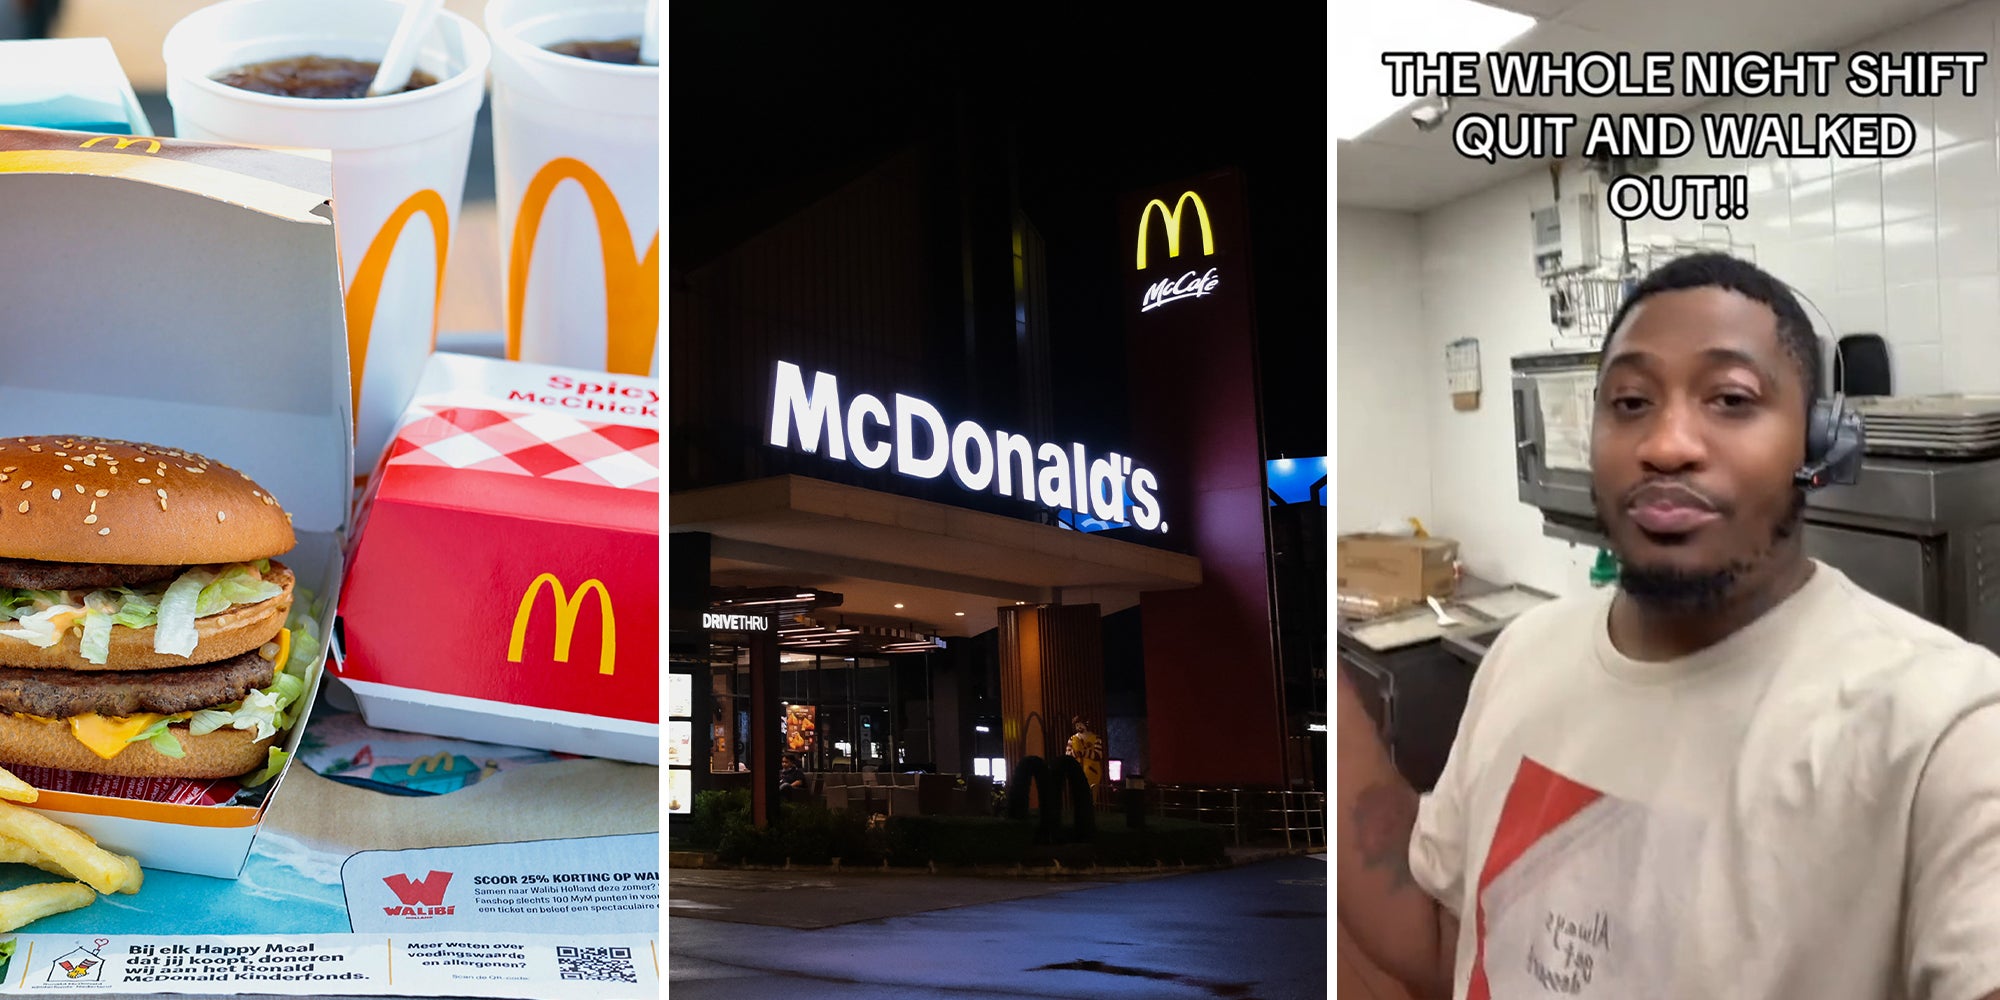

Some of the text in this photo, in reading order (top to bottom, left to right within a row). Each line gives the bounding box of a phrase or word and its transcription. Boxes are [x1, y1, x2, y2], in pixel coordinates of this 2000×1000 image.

[1142, 267, 1219, 311] McCafé
[474, 875, 518, 885] SCOOR
[521, 874, 549, 884] 25%
[553, 872, 610, 883] KORTING
[613, 872, 631, 882] OP
[474, 887, 506, 895] Samen
[530, 886, 559, 894] Walibi
[561, 884, 596, 893] Holland
[598, 884, 620, 892] deze
[622, 883, 656, 891] zomer?
[475, 896, 514, 905] Fanshop
[516, 895, 550, 904] slechts
[553, 895, 569, 903] 100
[570, 894, 593, 904] MyM
[594, 893, 630, 903] punten
[497, 904, 524, 913] ticket
[539, 904, 569, 913] beleef
[590, 902, 654, 912] spectaculaire
[129, 943, 314, 957] Bij elk Happy Meal
[407, 942, 525, 950] Meer weten over
[126, 953, 344, 967] dat jij koopt, doneren
[407, 951, 526, 961] voedingswaarde
[125, 963, 314, 975] wij aan het Ronald
[443, 959, 527, 969] allergenen?
[123, 972, 370, 983] McDonald Kinderfonds.
